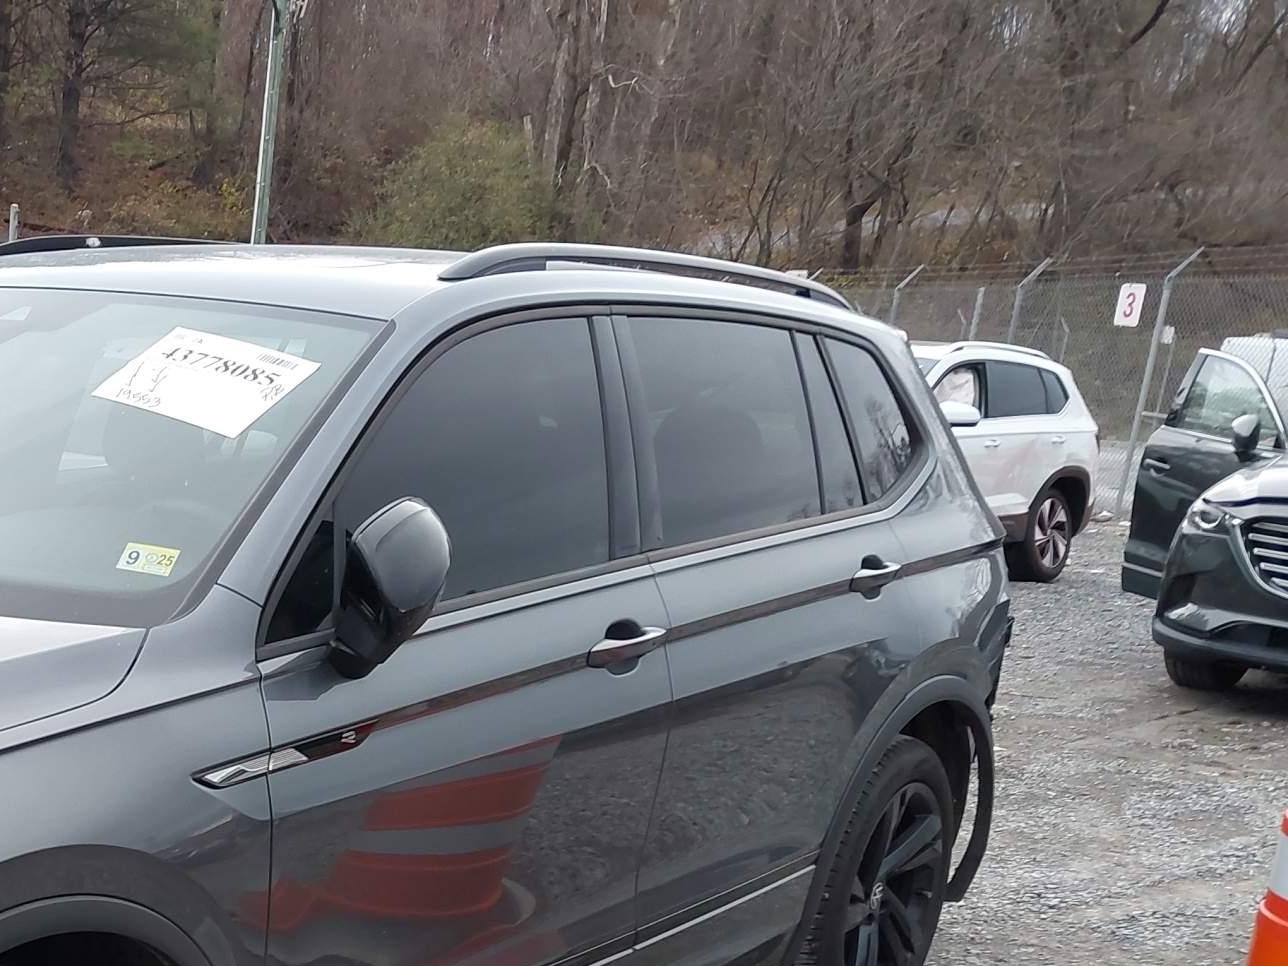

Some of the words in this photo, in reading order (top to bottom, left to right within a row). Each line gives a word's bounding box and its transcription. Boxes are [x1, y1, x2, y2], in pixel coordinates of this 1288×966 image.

[1123, 292, 1136, 318] 3
[161, 346, 281, 385] 43778085
[125, 550, 140, 565] 9
[157, 553, 175, 567] 25
